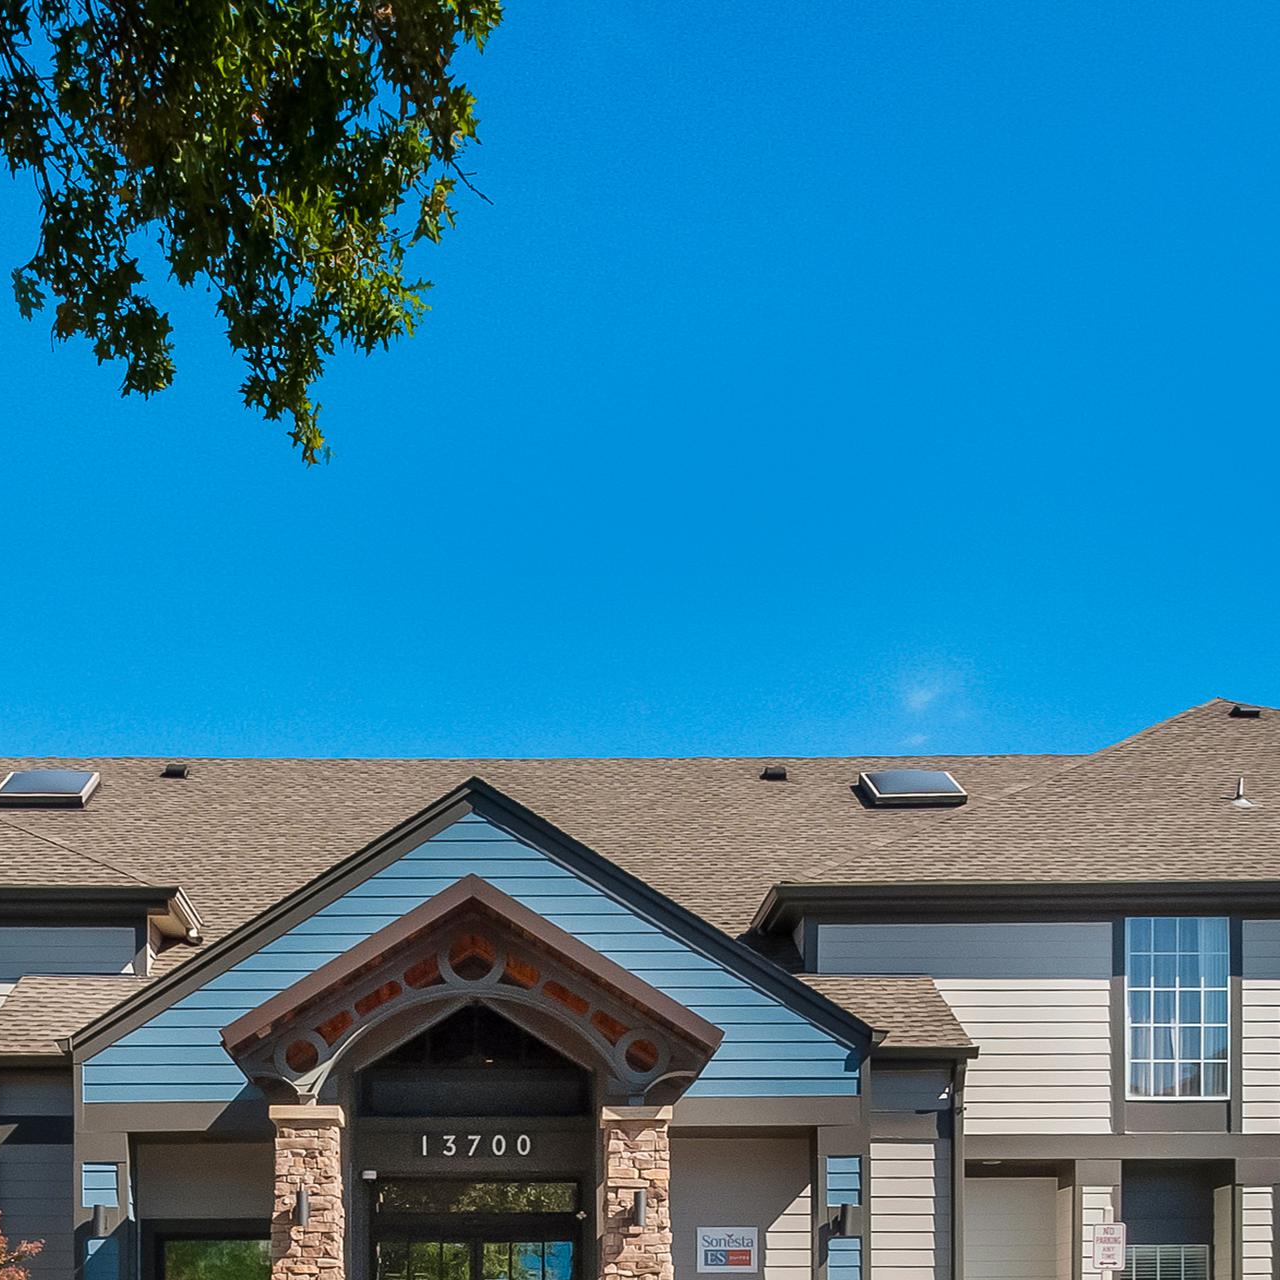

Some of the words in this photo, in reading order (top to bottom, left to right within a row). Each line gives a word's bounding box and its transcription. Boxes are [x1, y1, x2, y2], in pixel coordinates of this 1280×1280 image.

[422, 1135, 531, 1156] 13700
[1103, 1227, 1116, 1236] NO
[702, 1234, 754, 1248] Sonesta
[1095, 1236, 1122, 1244] PARKING
[706, 1251, 726, 1265] ES
